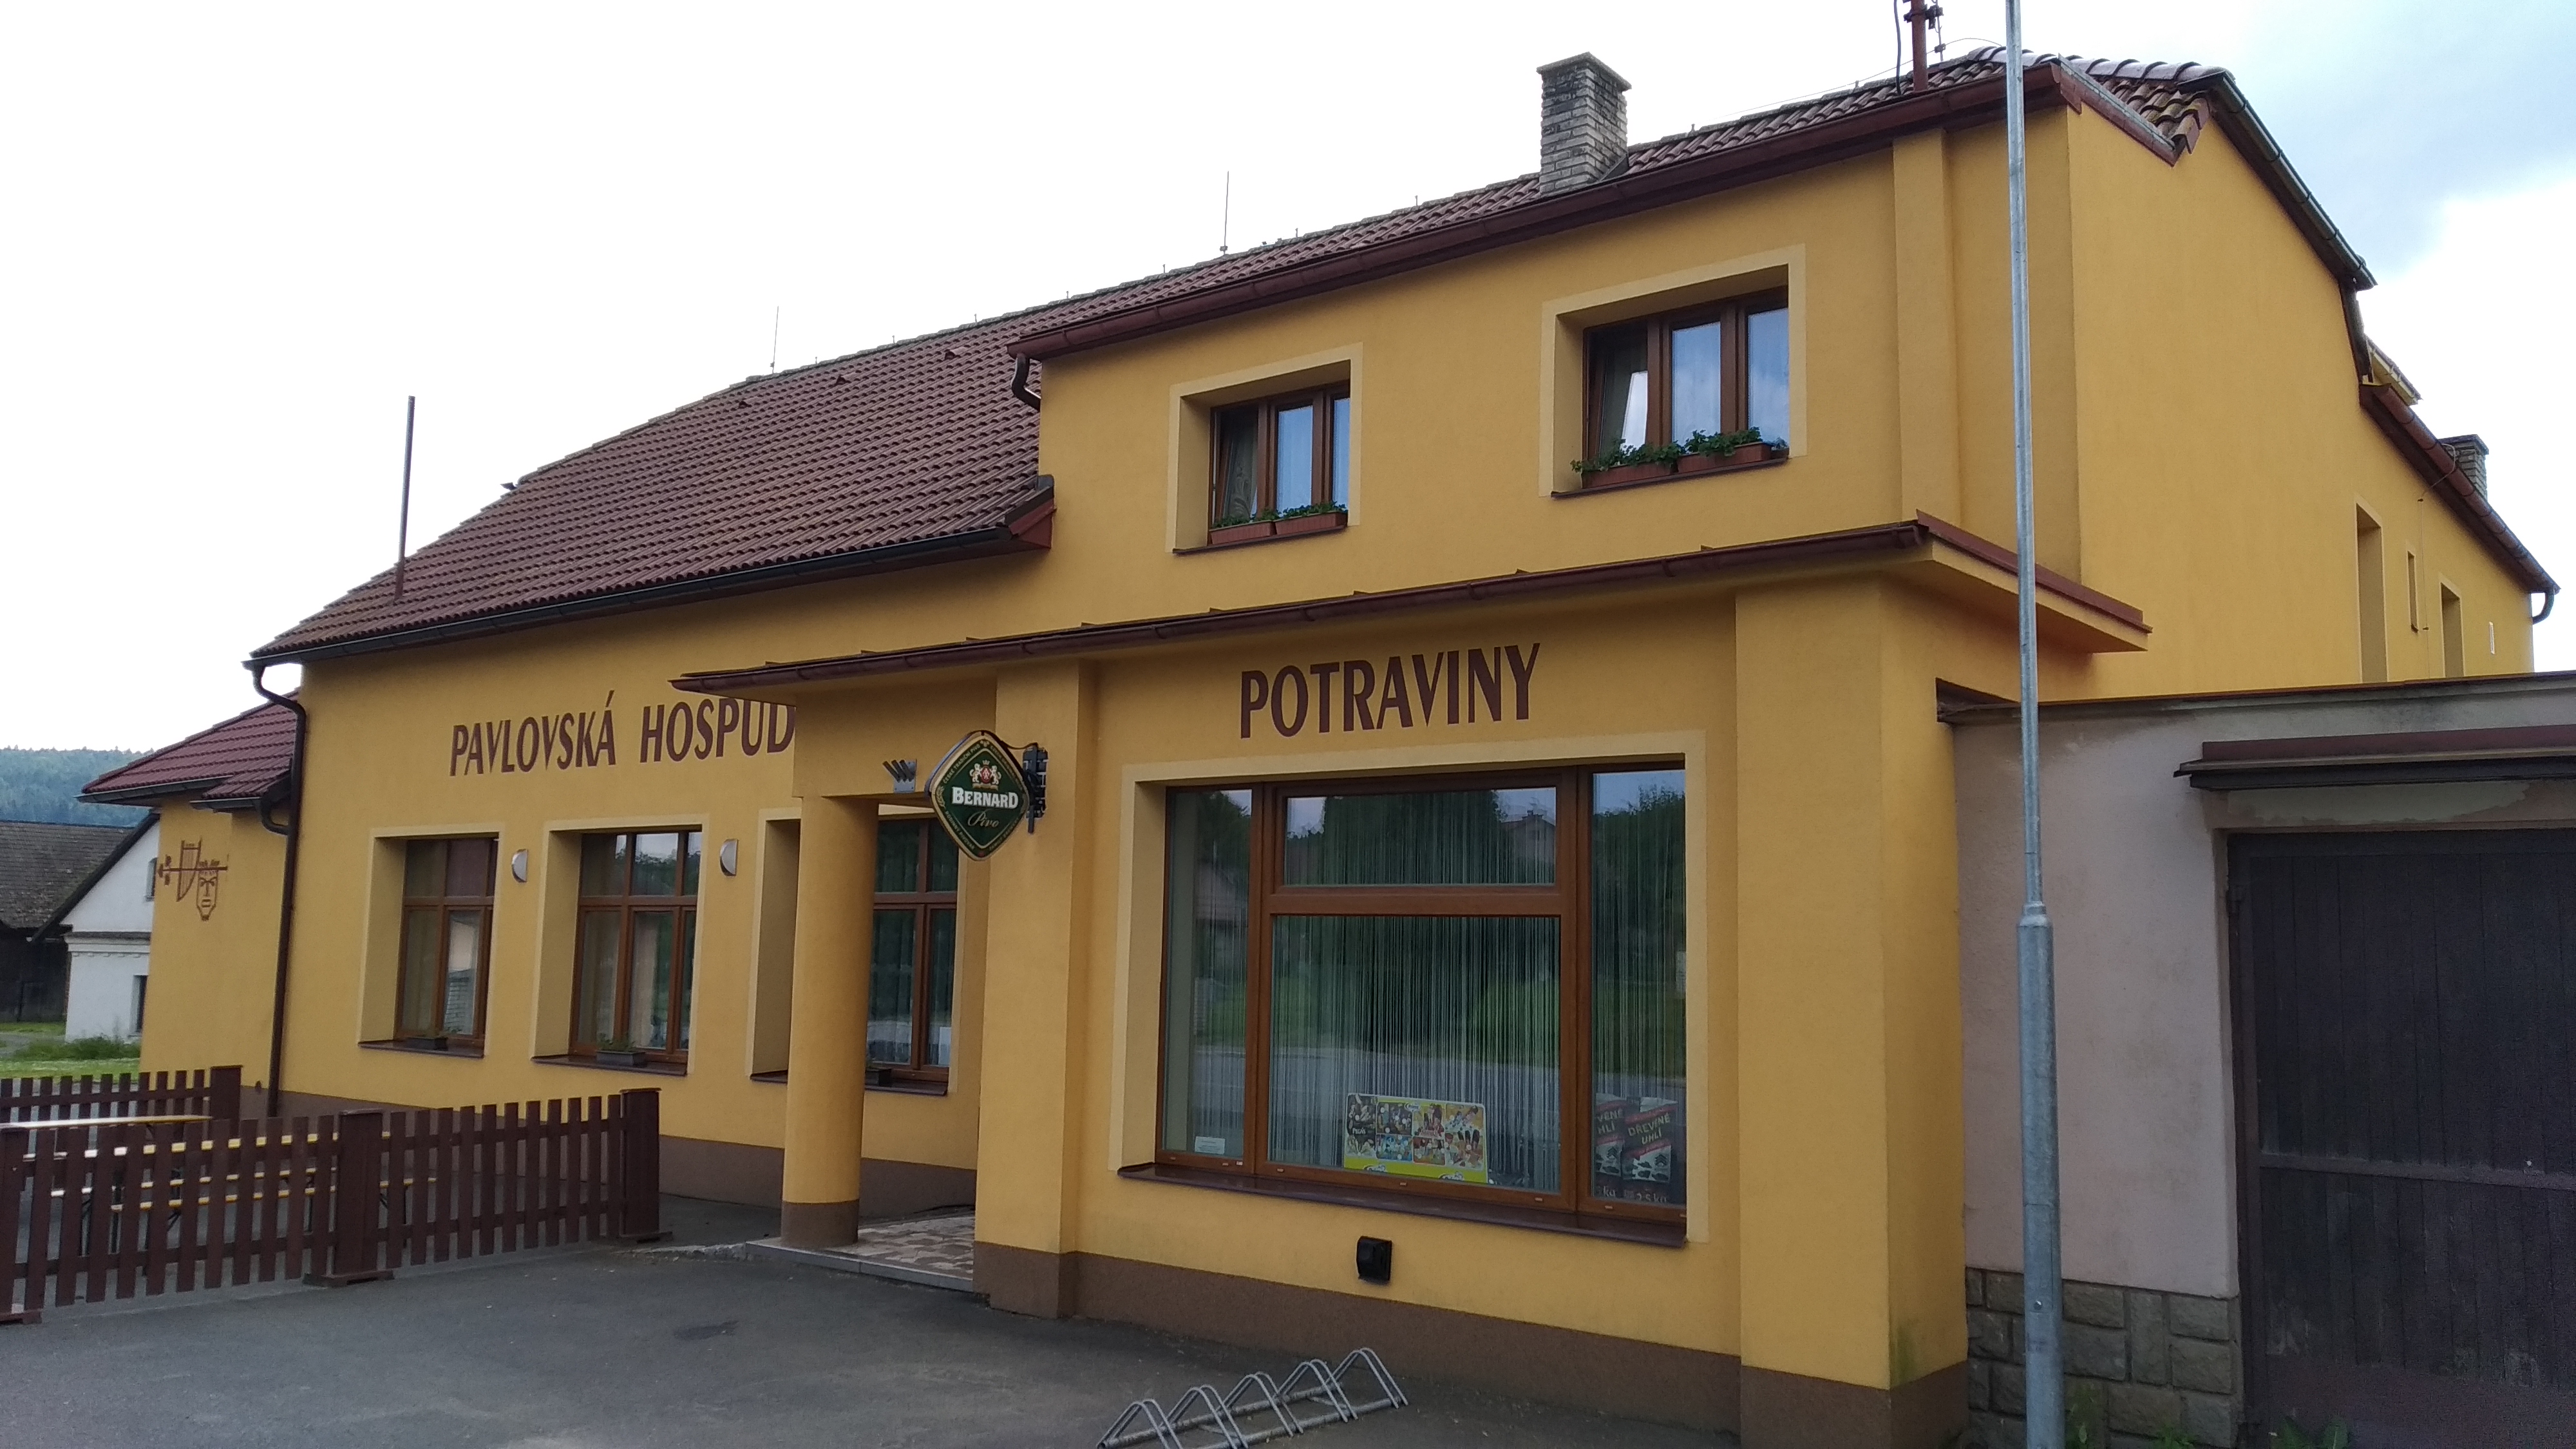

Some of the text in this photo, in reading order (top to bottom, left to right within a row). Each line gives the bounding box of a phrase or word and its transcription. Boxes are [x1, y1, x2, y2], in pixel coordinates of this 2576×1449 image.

[1240, 643, 1540, 739] POTRAVINY
[449, 690, 796, 777] PAVLOVSKÁ HOSPUD
[952, 786, 1018, 809] BERNARD
[967, 810, 999, 828] Pivo
